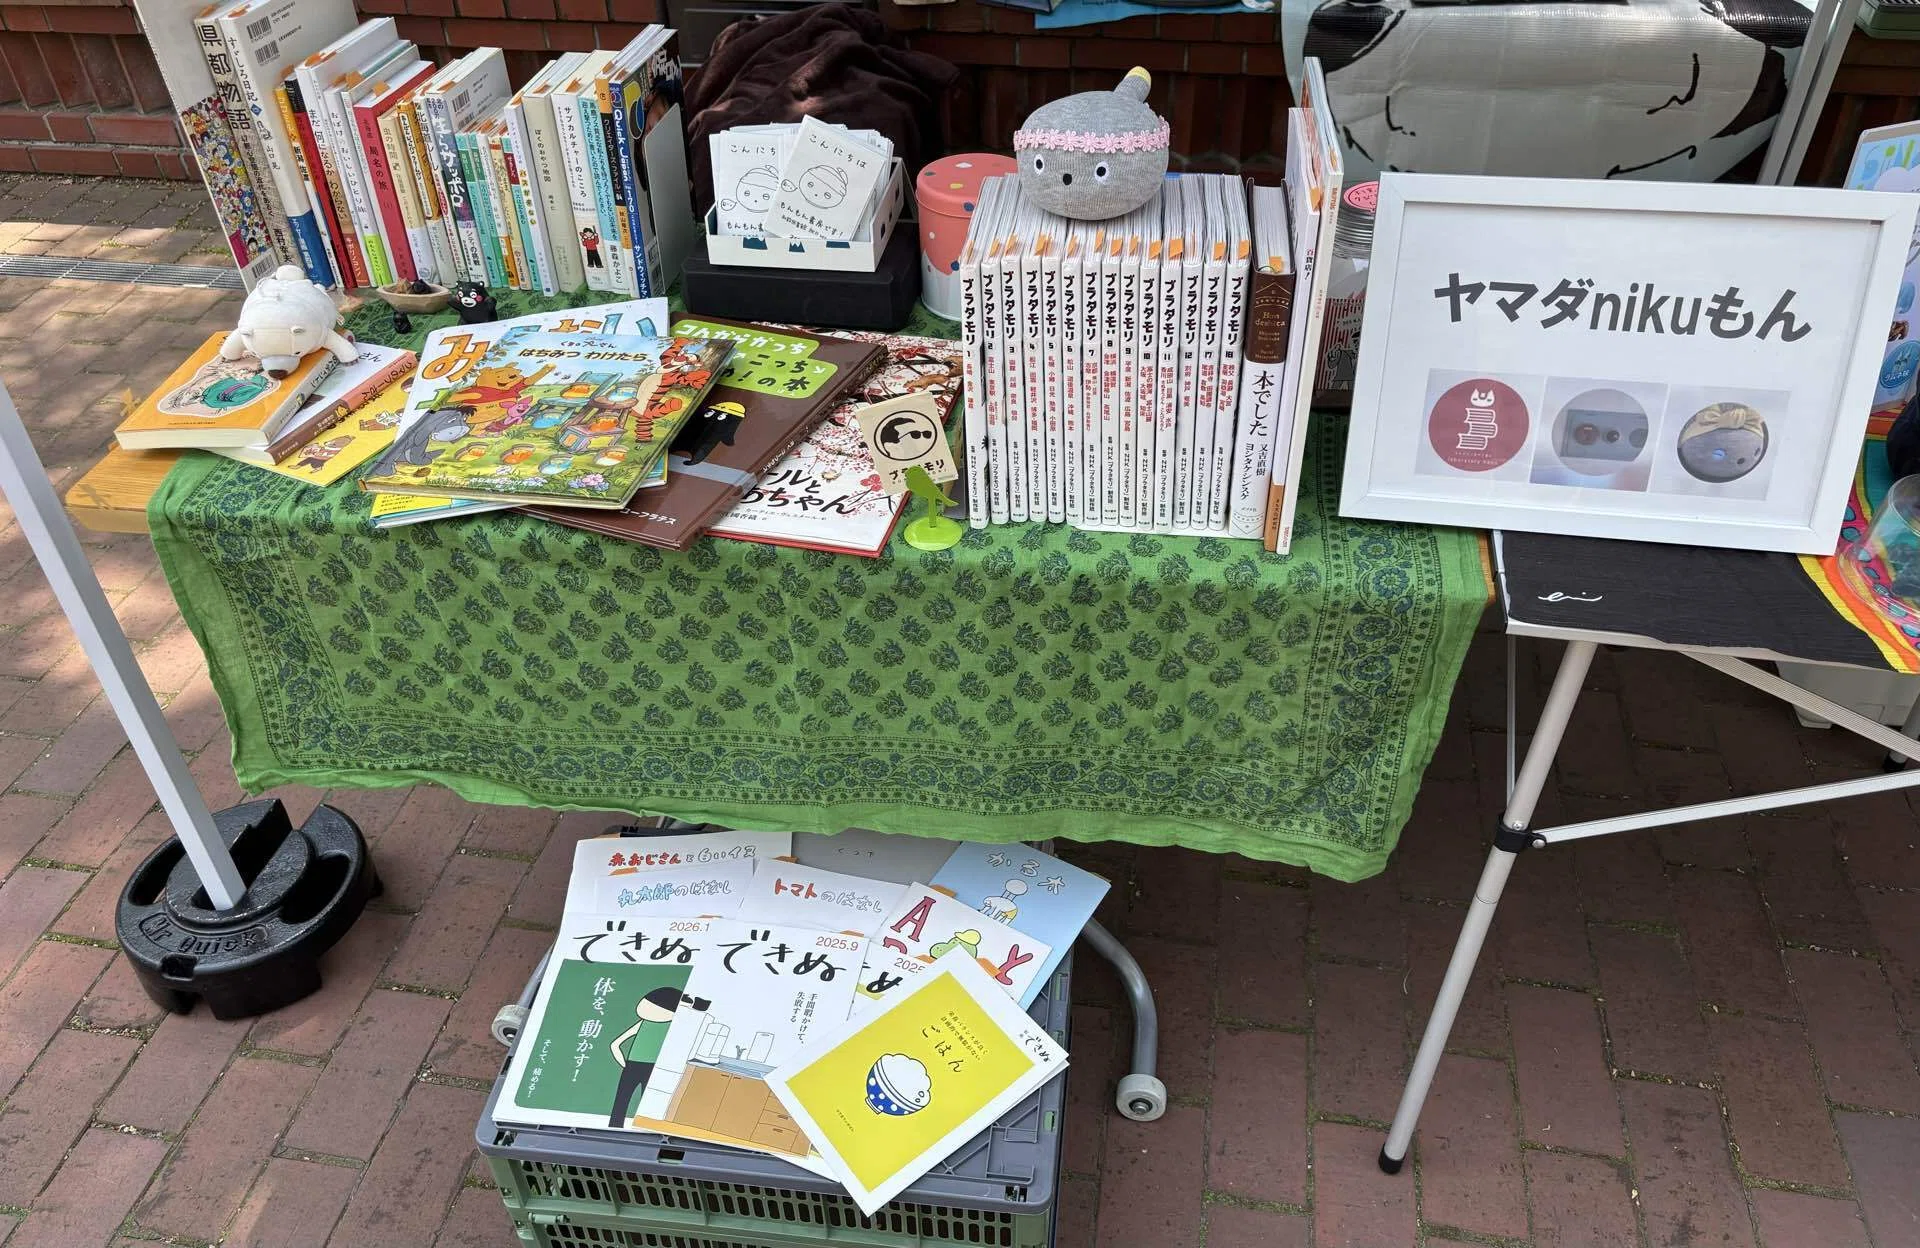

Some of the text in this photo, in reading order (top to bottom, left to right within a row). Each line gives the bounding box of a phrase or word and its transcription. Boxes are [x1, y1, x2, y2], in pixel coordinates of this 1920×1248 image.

[198, 24, 251, 131] 県都物語
[563, 107, 587, 198] サブカルチャーのこころ
[614, 109, 625, 145] Quick
[809, 134, 868, 169] こんにちは
[619, 146, 629, 182] Japan
[962, 279, 976, 346] ブラタモリ
[983, 274, 995, 350] ブラタモリ 2
[1003, 271, 1016, 354] ブラタモリ 3
[1026, 271, 1039, 338] ブラタモリ
[1045, 271, 1056, 338] ブラタモリ
[1064, 276, 1076, 340] ブラタモリ
[1085, 272, 1097, 340] ブラタモリ
[1124, 274, 1134, 342] ブラタモリ
[1142, 278, 1154, 346] ブラタモリ
[1164, 280, 1176, 347] ブラタモリ
[1185, 276, 1198, 344] ブラタモリ
[1206, 277, 1220, 345] ブラタモリ
[1228, 276, 1243, 346] ブラタモリ
[1433, 272, 1813, 344] ヤマダnikuもん
[518, 348, 648, 362] はちみつ わけたら
[1106, 340, 1113, 348] 8
[1249, 370, 1275, 437] 本でした
[888, 458, 945, 481] ブモリ
[1240, 442, 1255, 501] ヨシタケシンスケ
[1256, 443, 1269, 476] 又吉直樹
[620, 508, 680, 525] ユーフラテス
[774, 878, 883, 913] トマトのはなし
[177, 930, 258, 956] Quick
[572, 920, 702, 964] できぬ
[669, 921, 710, 932] 2026.1
[716, 929, 848, 983] できぬ
[816, 936, 859, 951] 2025.9
[569, 976, 618, 1083] 体を、動かす！
[789, 991, 806, 1024] 失敗する
[922, 1025, 965, 1073] ごはん
[1026, 1036, 1051, 1063] できぬ
